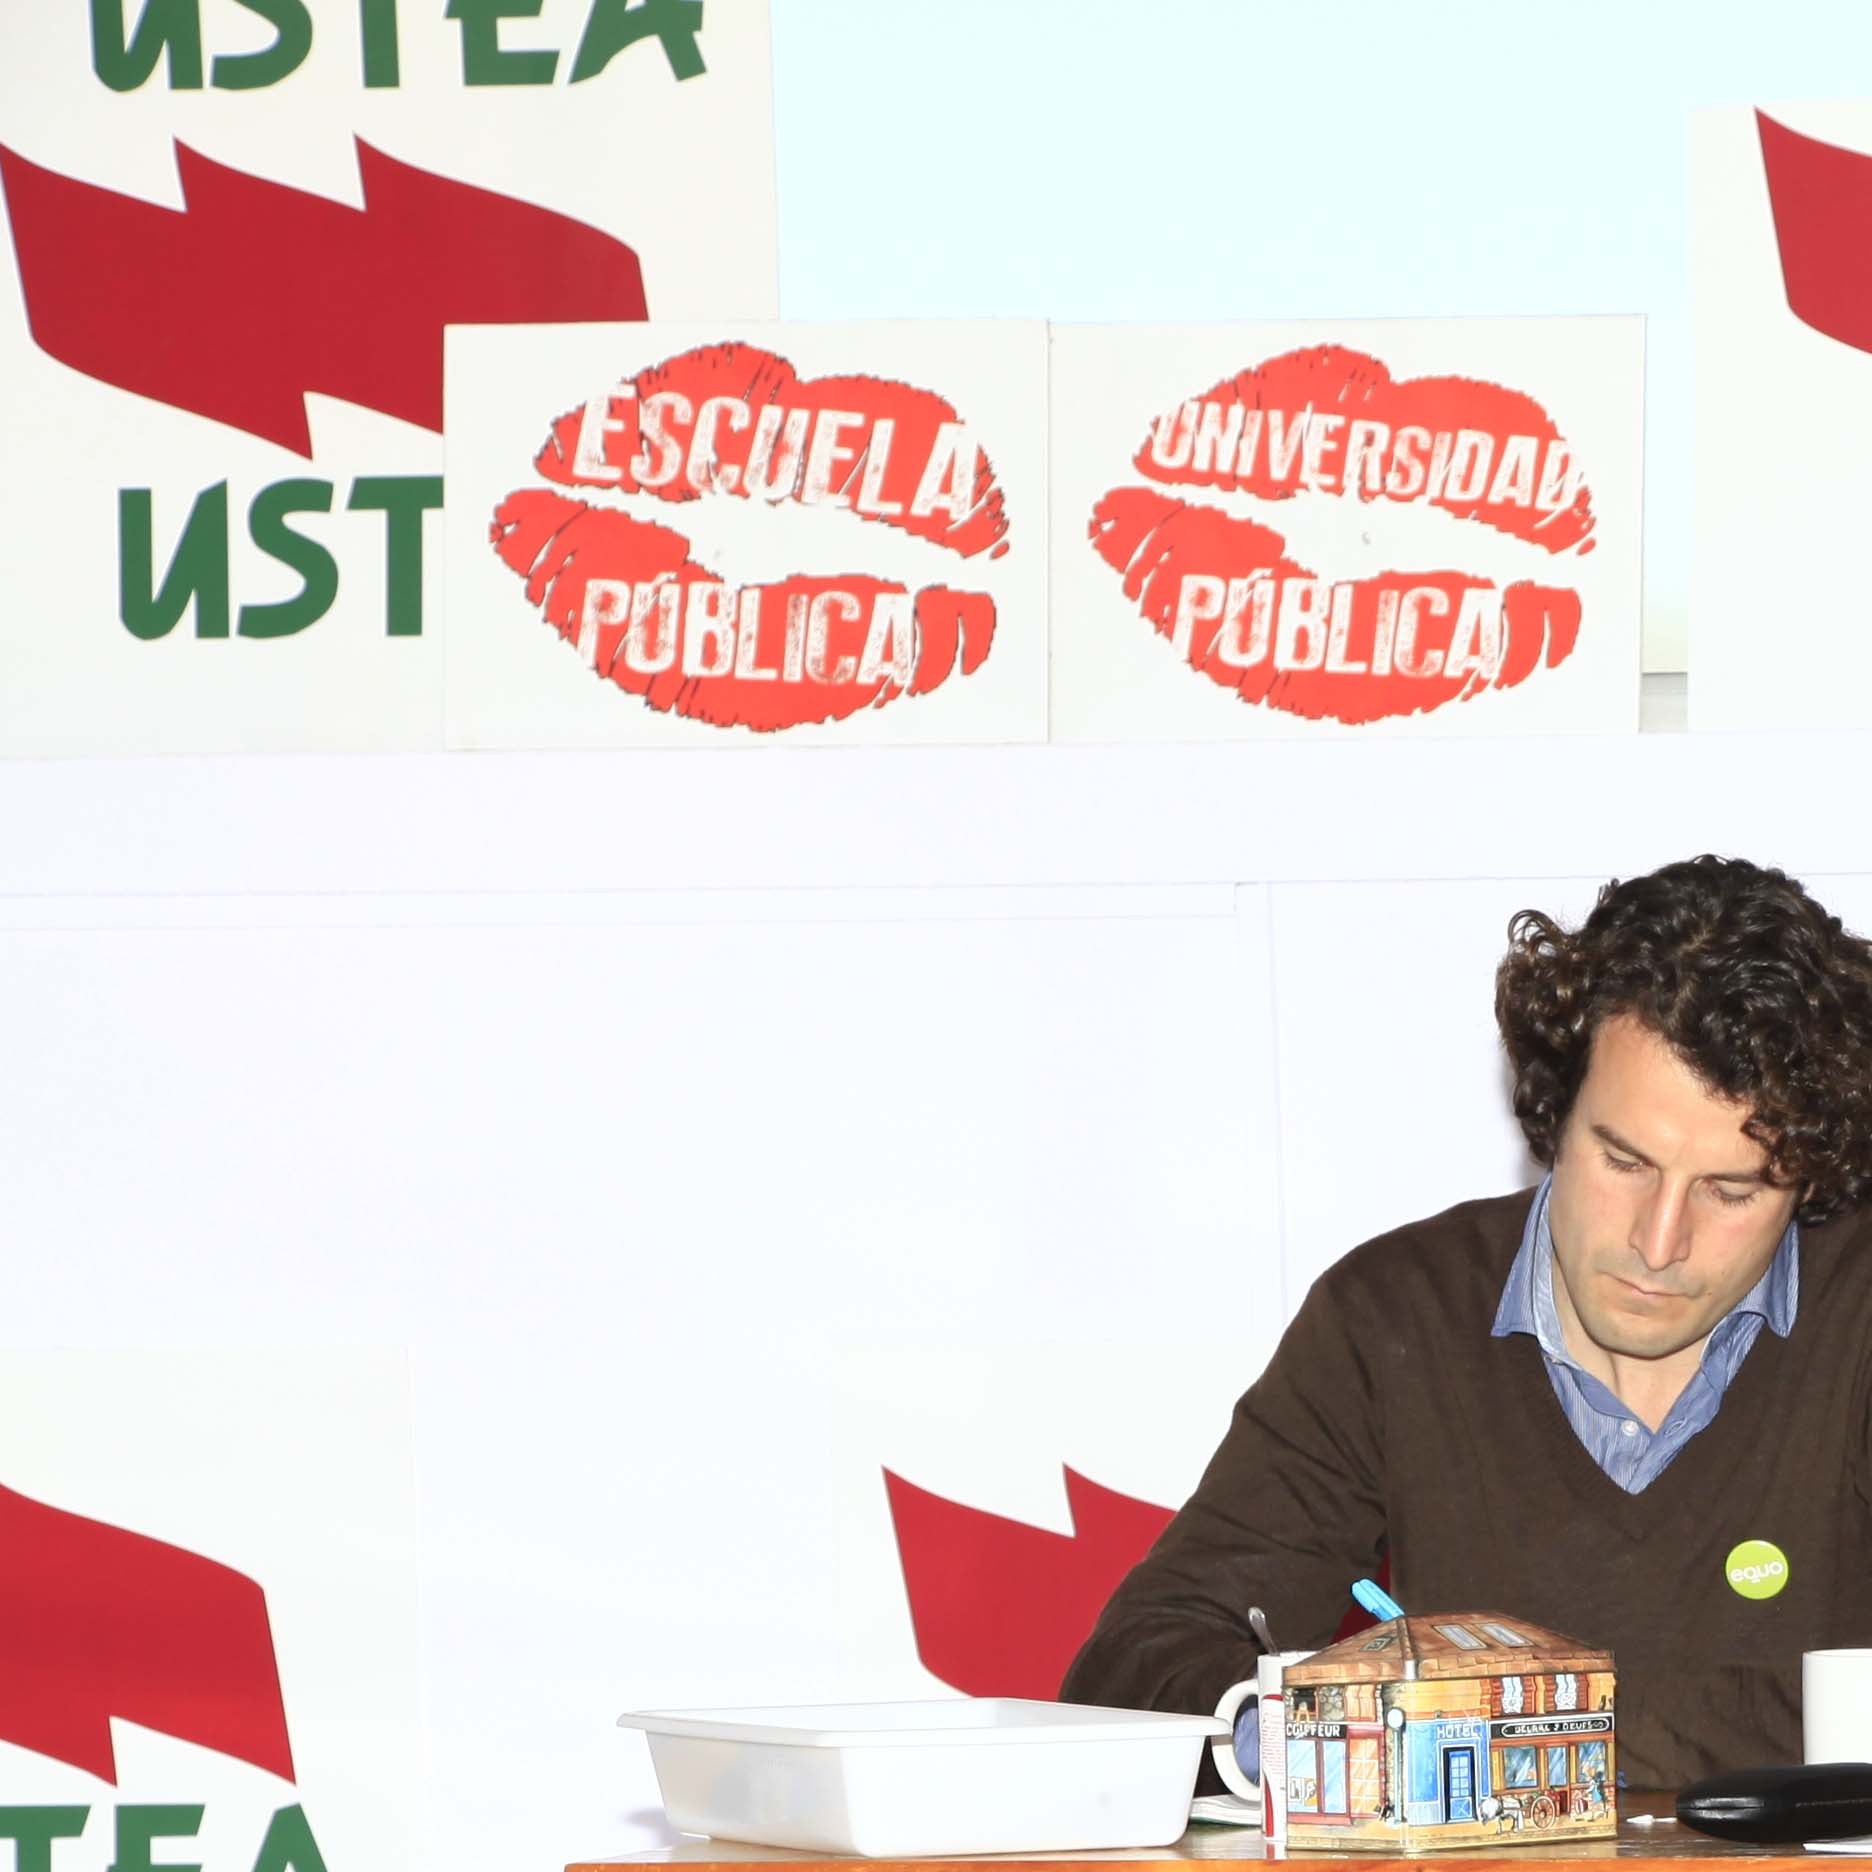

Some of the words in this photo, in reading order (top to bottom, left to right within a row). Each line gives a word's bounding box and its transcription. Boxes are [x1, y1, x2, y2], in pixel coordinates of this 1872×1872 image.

[573, 382, 979, 522] ESCUELA
[1152, 397, 1586, 513] UNIVERSIDAD
[577, 572, 917, 686] PÚBLICA
[1172, 565, 1502, 679] PÚBLICA
[1731, 1561, 1784, 1584] equo
[1286, 1722, 1341, 1739] COIFFEUR
